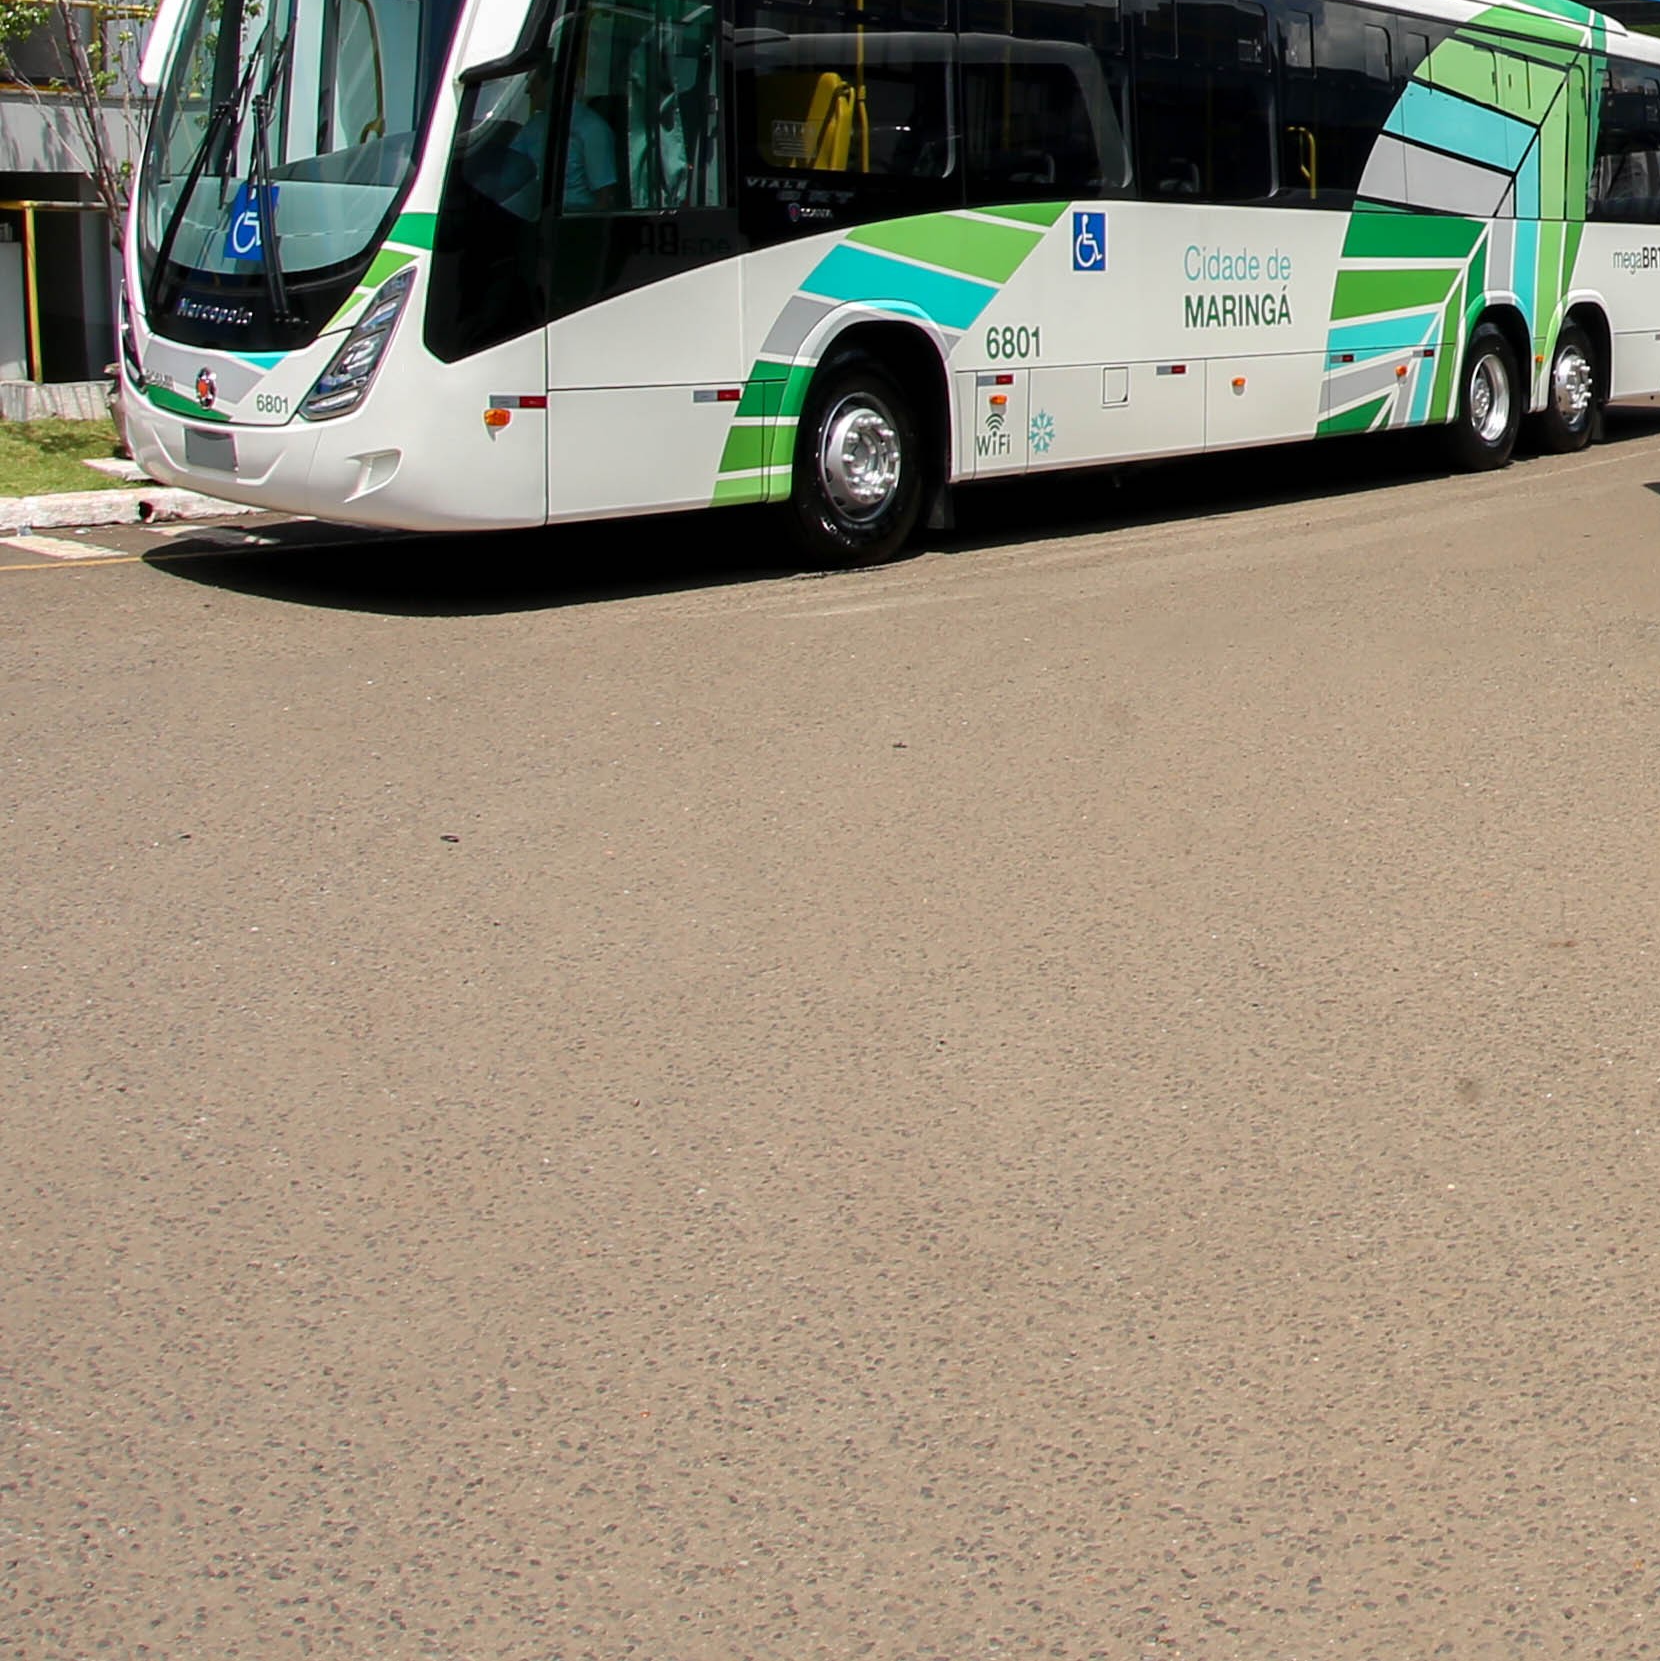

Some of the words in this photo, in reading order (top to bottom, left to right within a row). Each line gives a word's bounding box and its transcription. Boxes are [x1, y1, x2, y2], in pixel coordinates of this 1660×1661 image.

[1184, 245, 1260, 281] Cidade
[1267, 247, 1291, 281] de
[177, 297, 253, 325] Marcopolo
[1184, 284, 1292, 328] MARINGÁ
[986, 325, 1041, 360] 6801
[256, 394, 289, 414] 6801
[976, 432, 1011, 457] WiFi
